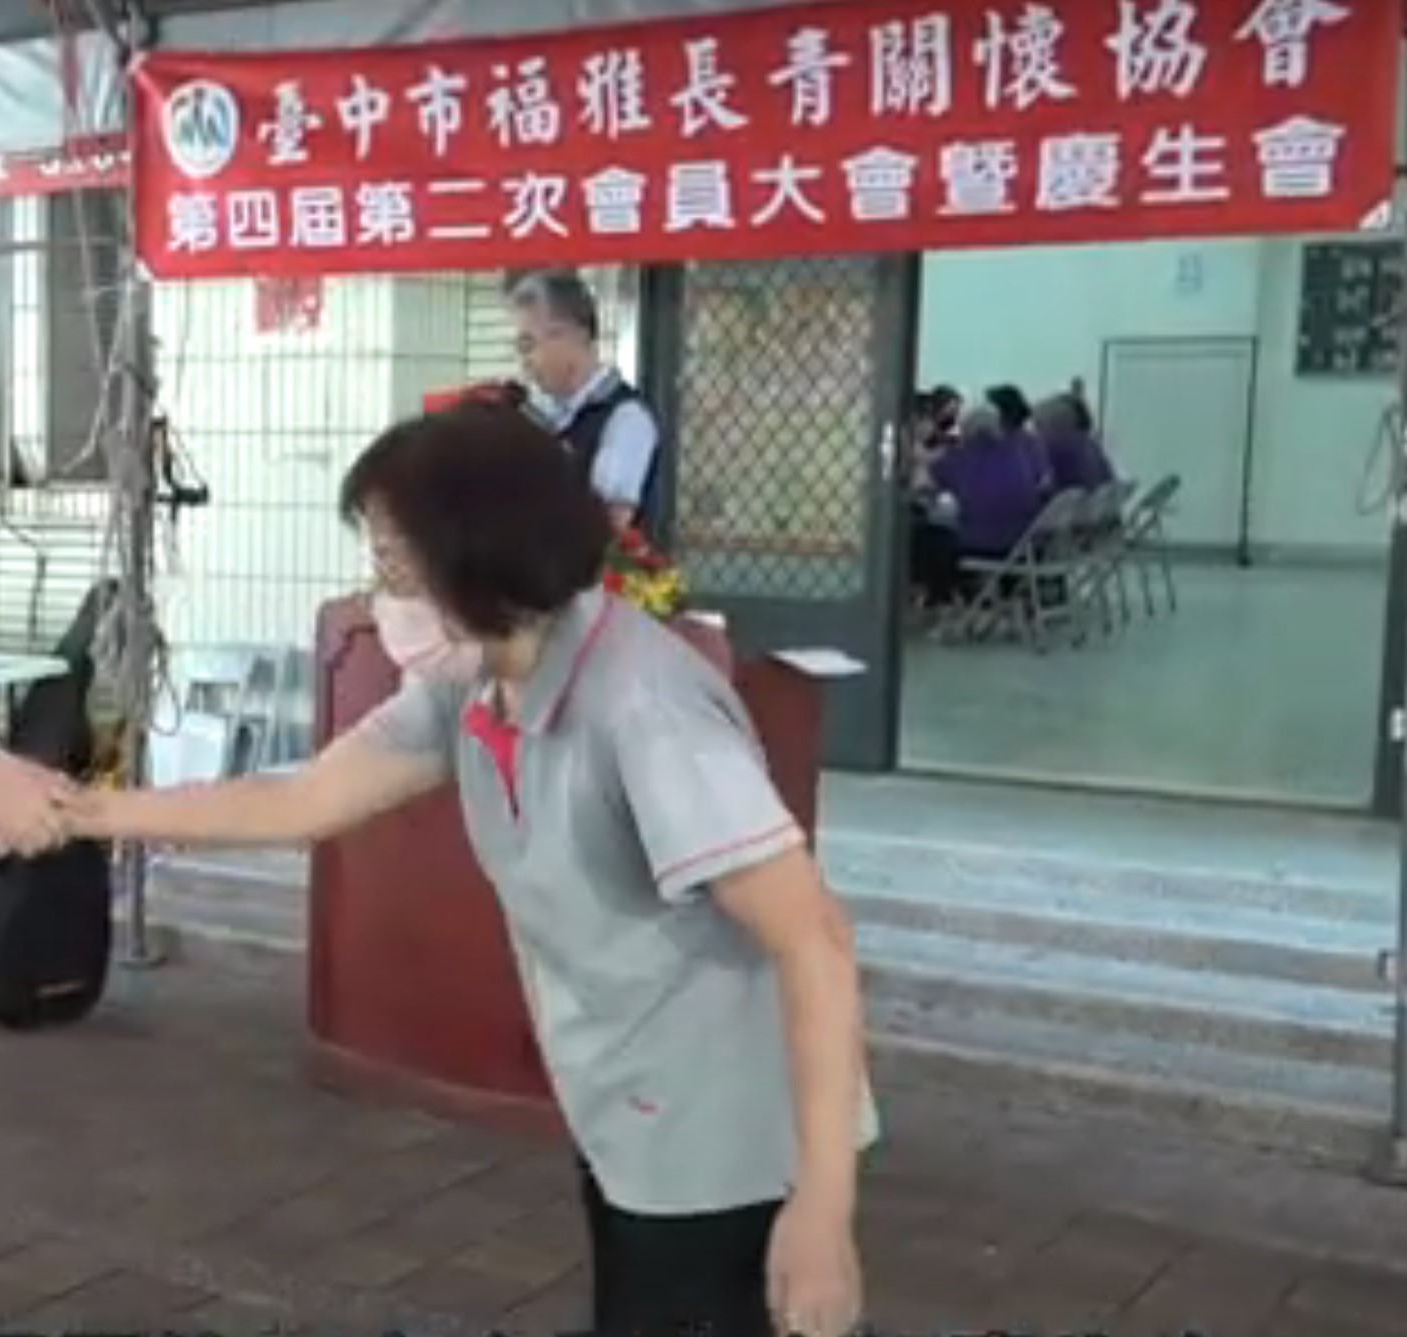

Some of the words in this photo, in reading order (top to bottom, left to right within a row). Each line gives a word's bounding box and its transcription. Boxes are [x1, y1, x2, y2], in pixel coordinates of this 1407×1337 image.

[258, 0, 1350, 165] 臺中市福雅長青關懷協會
[167, 116, 1345, 252] 第四屆第二次會員大會暨慶生會
